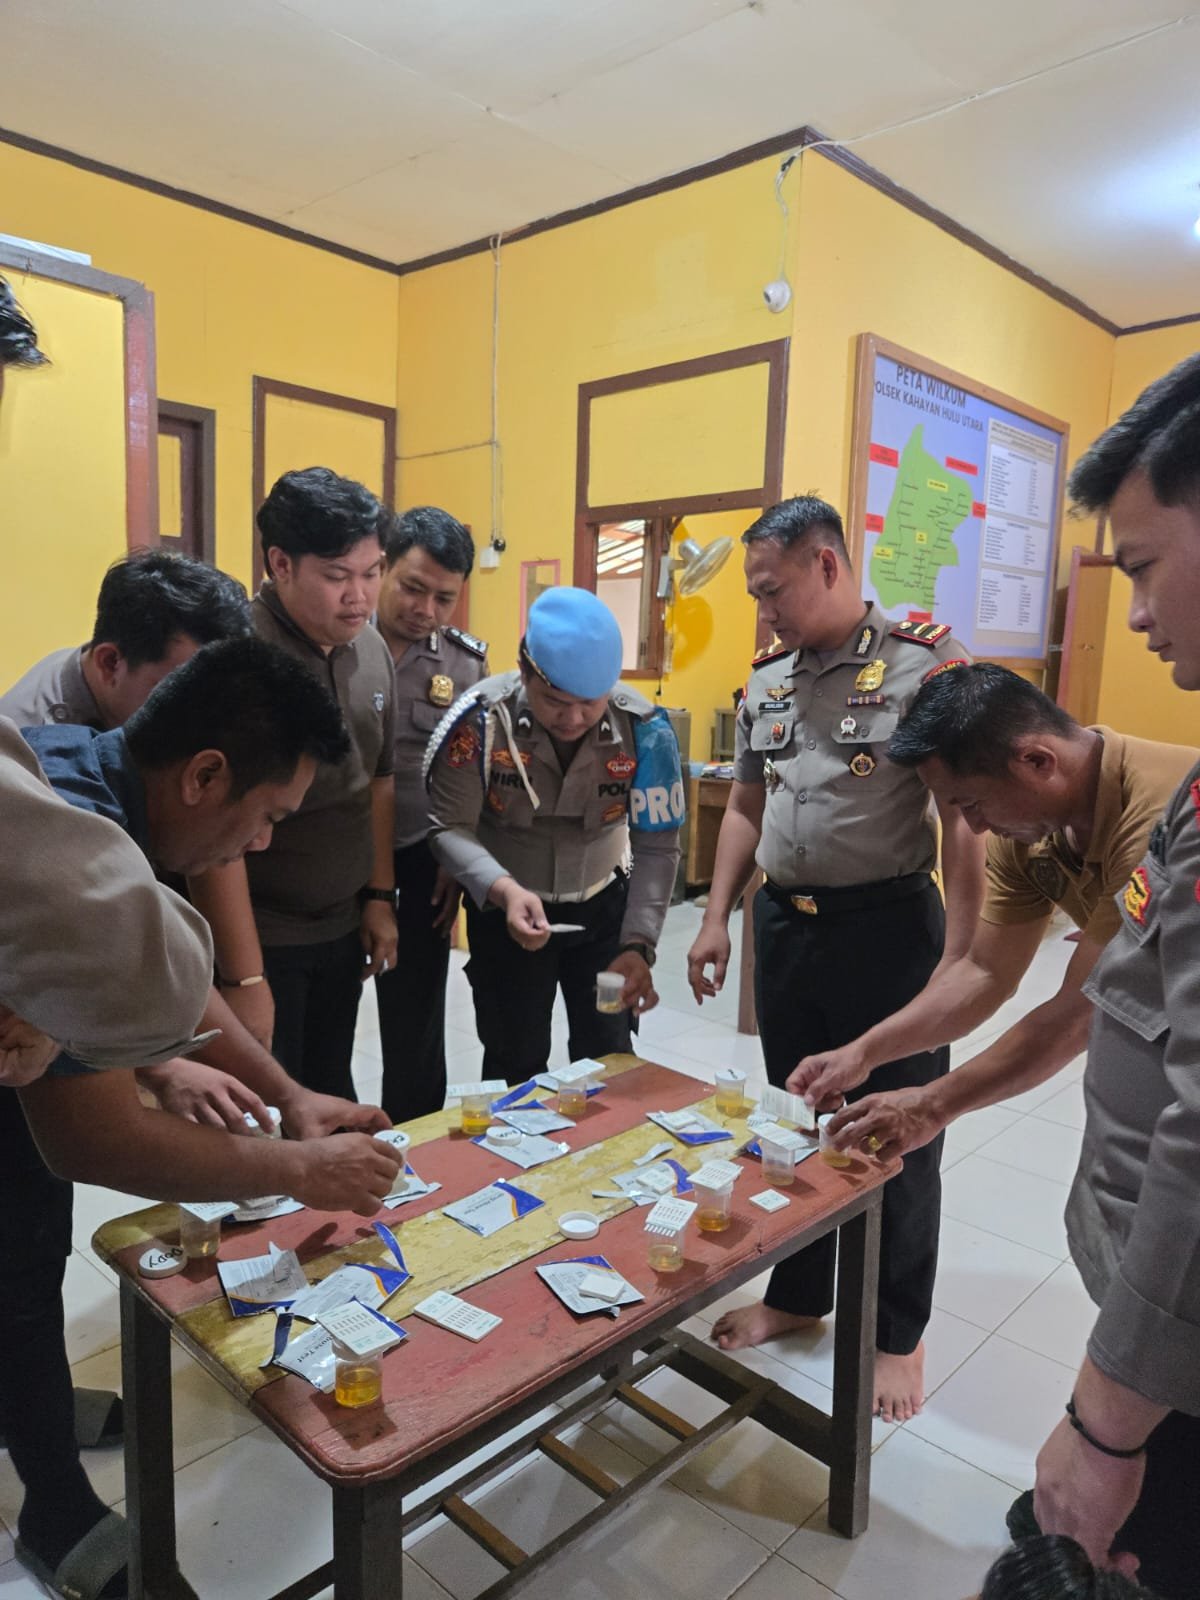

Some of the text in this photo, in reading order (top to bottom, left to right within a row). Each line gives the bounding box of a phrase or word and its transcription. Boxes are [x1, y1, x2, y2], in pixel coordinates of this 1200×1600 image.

[875, 380, 984, 432] OLSEK KAHAYAN HULU UTARA
[896, 364, 966, 408] PETA WILKUM
